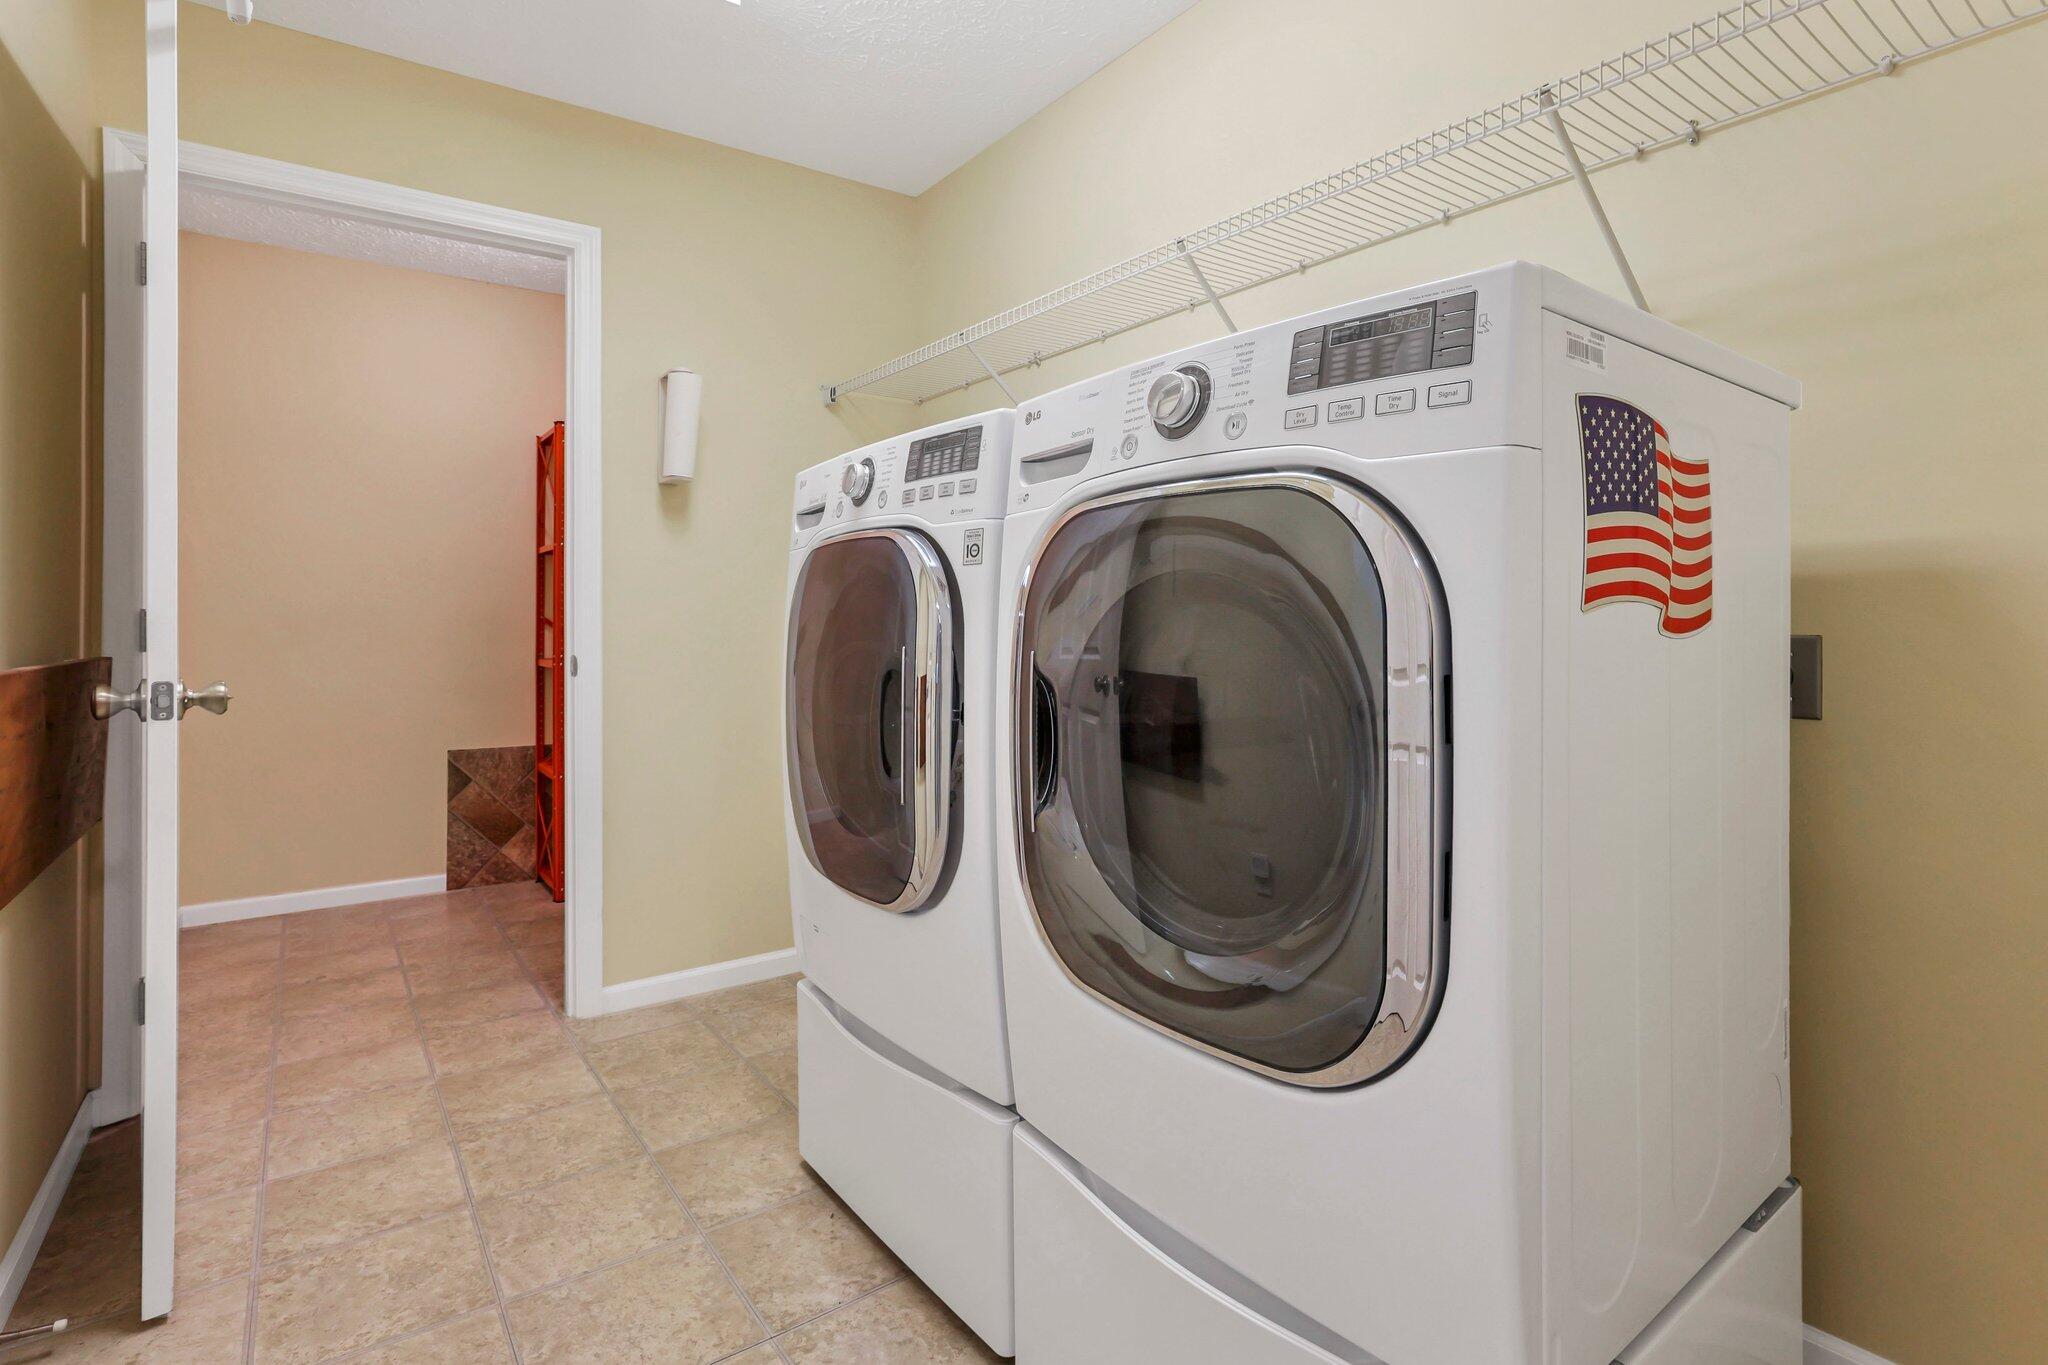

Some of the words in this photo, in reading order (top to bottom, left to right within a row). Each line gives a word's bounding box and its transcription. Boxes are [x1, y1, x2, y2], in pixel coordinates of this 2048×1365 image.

[1438, 390, 1458, 399] Signal
[1337, 404, 1352, 412] Temp
[1335, 410, 1354, 418] Control
[966, 543, 980, 558] 10
